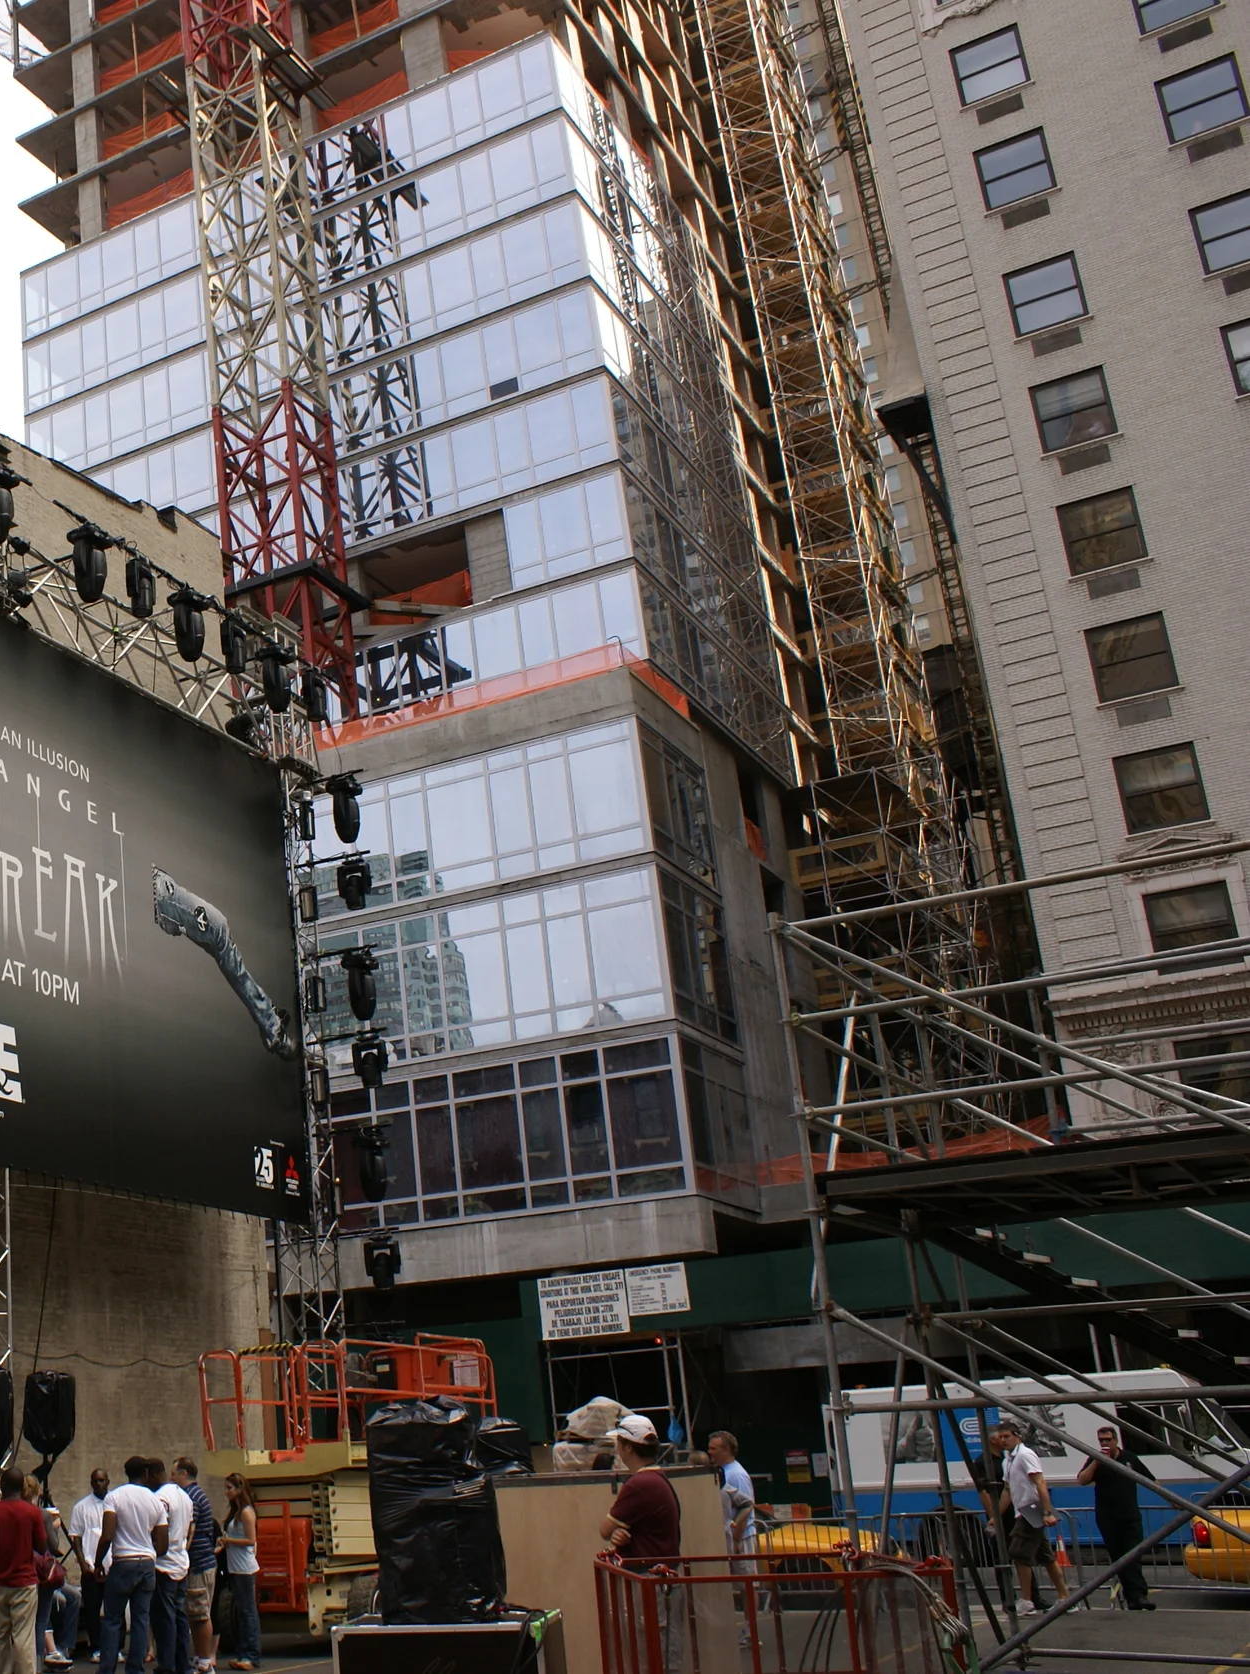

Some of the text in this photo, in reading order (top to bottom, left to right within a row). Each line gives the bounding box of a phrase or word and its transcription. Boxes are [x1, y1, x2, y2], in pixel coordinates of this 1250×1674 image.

[0, 726, 21, 750] AN
[27, 738, 90, 783] ILLUSION
[1, 958, 25, 987] AT
[32, 968, 79, 1005] 10PM
[254, 1146, 274, 1184] 25
[540, 1272, 620, 1288] TO ANONYMOUSLY REPORT UNSAFE
[540, 1288, 563, 1298] CONDITIONS
[564, 1288, 568, 1296] AT
[570, 1286, 579, 1295] THIS
[580, 1285, 592, 1294] WORK
[604, 1283, 613, 1291] CALL
[614, 1281, 624, 1290] 311
[546, 1293, 619, 1309] PARA REPORTAR CONDICIONES
[554, 1307, 584, 1318] PELIGROSAS
[585, 1306, 591, 1314] EN
[592, 1305, 599, 1314] UN
[552, 1320, 558, 1328] DE
[584, 1316, 600, 1325] LLAME
[610, 1314, 619, 1322] 311
[548, 1330, 556, 1338] NO
[557, 1328, 570, 1337] TIENE
[571, 1327, 581, 1335] QUE
[582, 1326, 592, 1335] DAR
[593, 1325, 600, 1334] SU
